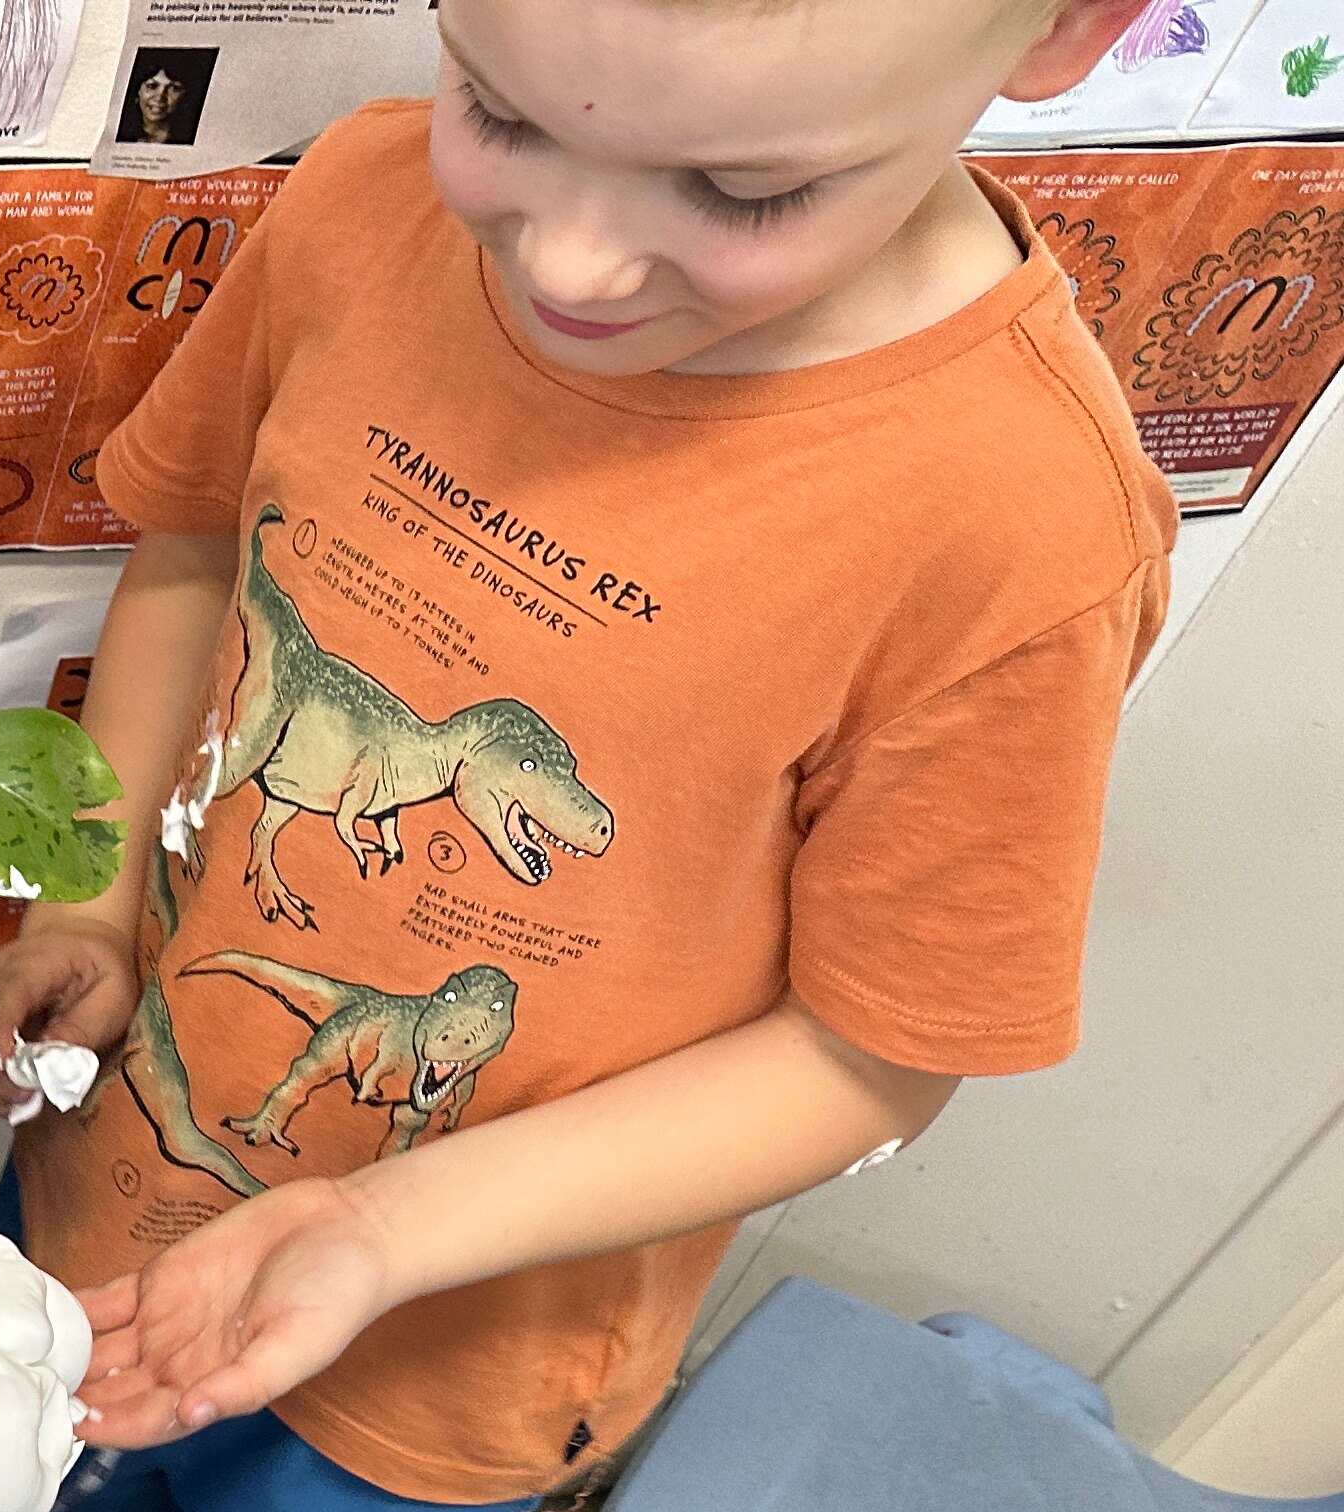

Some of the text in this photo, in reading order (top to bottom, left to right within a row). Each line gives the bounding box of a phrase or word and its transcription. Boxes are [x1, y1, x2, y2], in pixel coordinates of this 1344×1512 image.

[366, 425, 662, 623] TYRANNOSAURUS REX
[362, 490, 579, 639] KING OF THE DINOSAURS
[364, 580, 407, 614] METRES
[431, 625, 450, 645] THE
[468, 656, 490, 676] AND
[375, 565, 388, 579] UP
[391, 576, 405, 591] TO
[423, 599, 463, 634] METRES
[465, 630, 476, 645] IN
[386, 616, 401, 630] TO
[438, 845, 453, 863] 3
[408, 907, 559, 968] FEATURED TWO CLAWED
[416, 894, 583, 960] EXTREMELY POWERFUL AND
[532, 922, 565, 938] THAT
[568, 932, 602, 950] WERE
